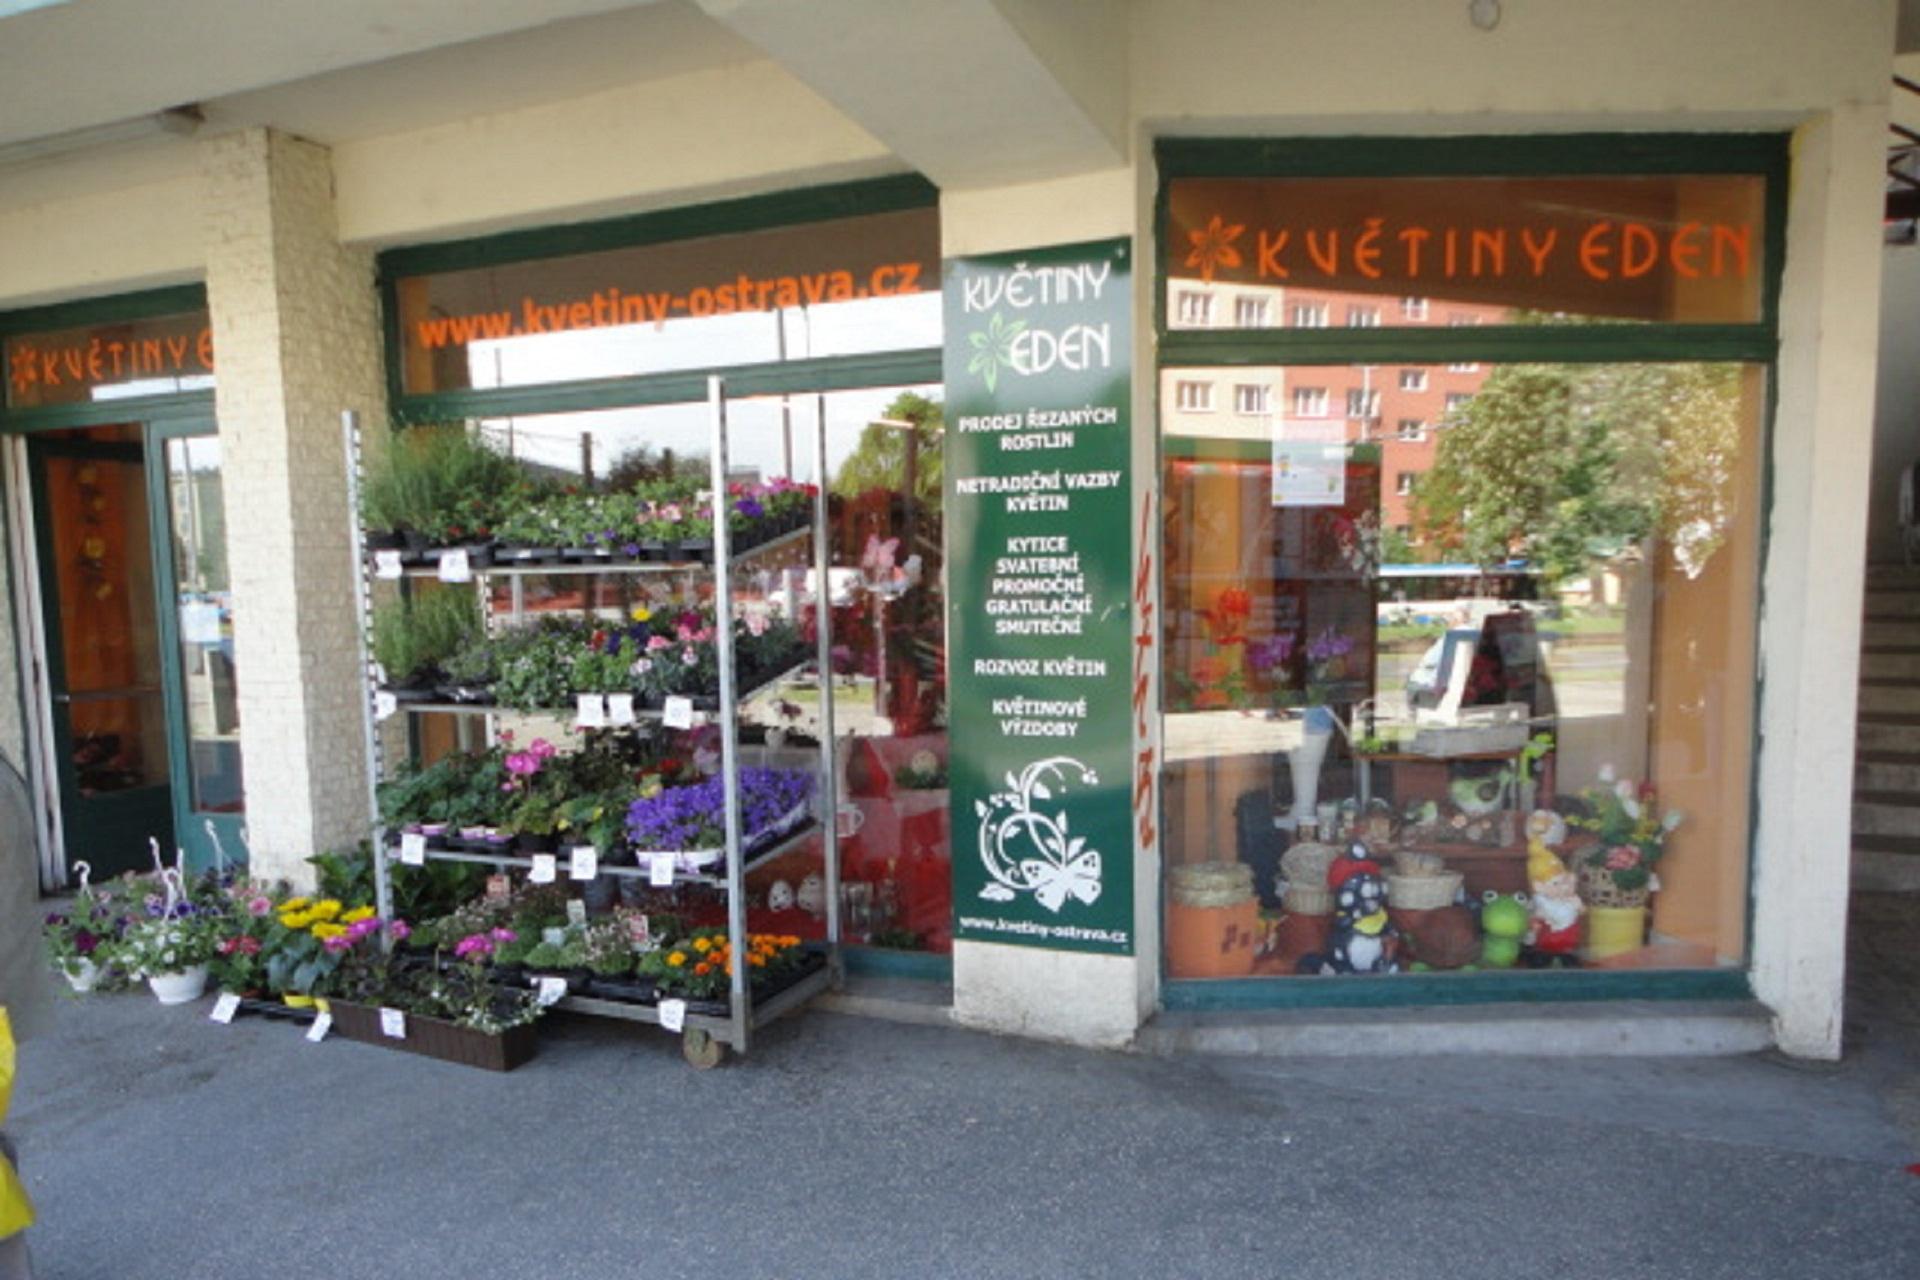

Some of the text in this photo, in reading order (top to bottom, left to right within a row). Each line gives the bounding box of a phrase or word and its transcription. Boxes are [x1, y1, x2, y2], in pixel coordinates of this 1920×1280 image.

[1257, 217, 1752, 281] KVĚTINY EDEN
[963, 261, 1111, 313] KVĚTINY
[418, 262, 922, 349] www.kvetiny-ostrava.cz
[1010, 322, 1111, 376] EDEN
[42, 335, 188, 386] KVĚTINY
[959, 404, 1117, 432] PRODEJ ŘEZANÝCH
[1001, 432, 1074, 450] ROSTLIN
[956, 470, 1121, 494] NETRADIČNÍ VAZBY
[1006, 493, 1069, 513] KVĚTIN
[1007, 536, 1068, 553] KYTICE
[996, 552, 1079, 574] SVATEBNÍ
[992, 572, 1084, 594] PROMOČNÍ
[985, 594, 1092, 614] GRATULAČNÍ
[995, 615, 1082, 634] SMUTEČNÍ
[974, 655, 1106, 676] ROZVOZ KVĚTIN
[992, 695, 1087, 718] KVĚTINOVÉ
[1001, 717, 1078, 737] VÝZDOBY
[959, 916, 1128, 944] www.kvetiny-ostrava.cz
